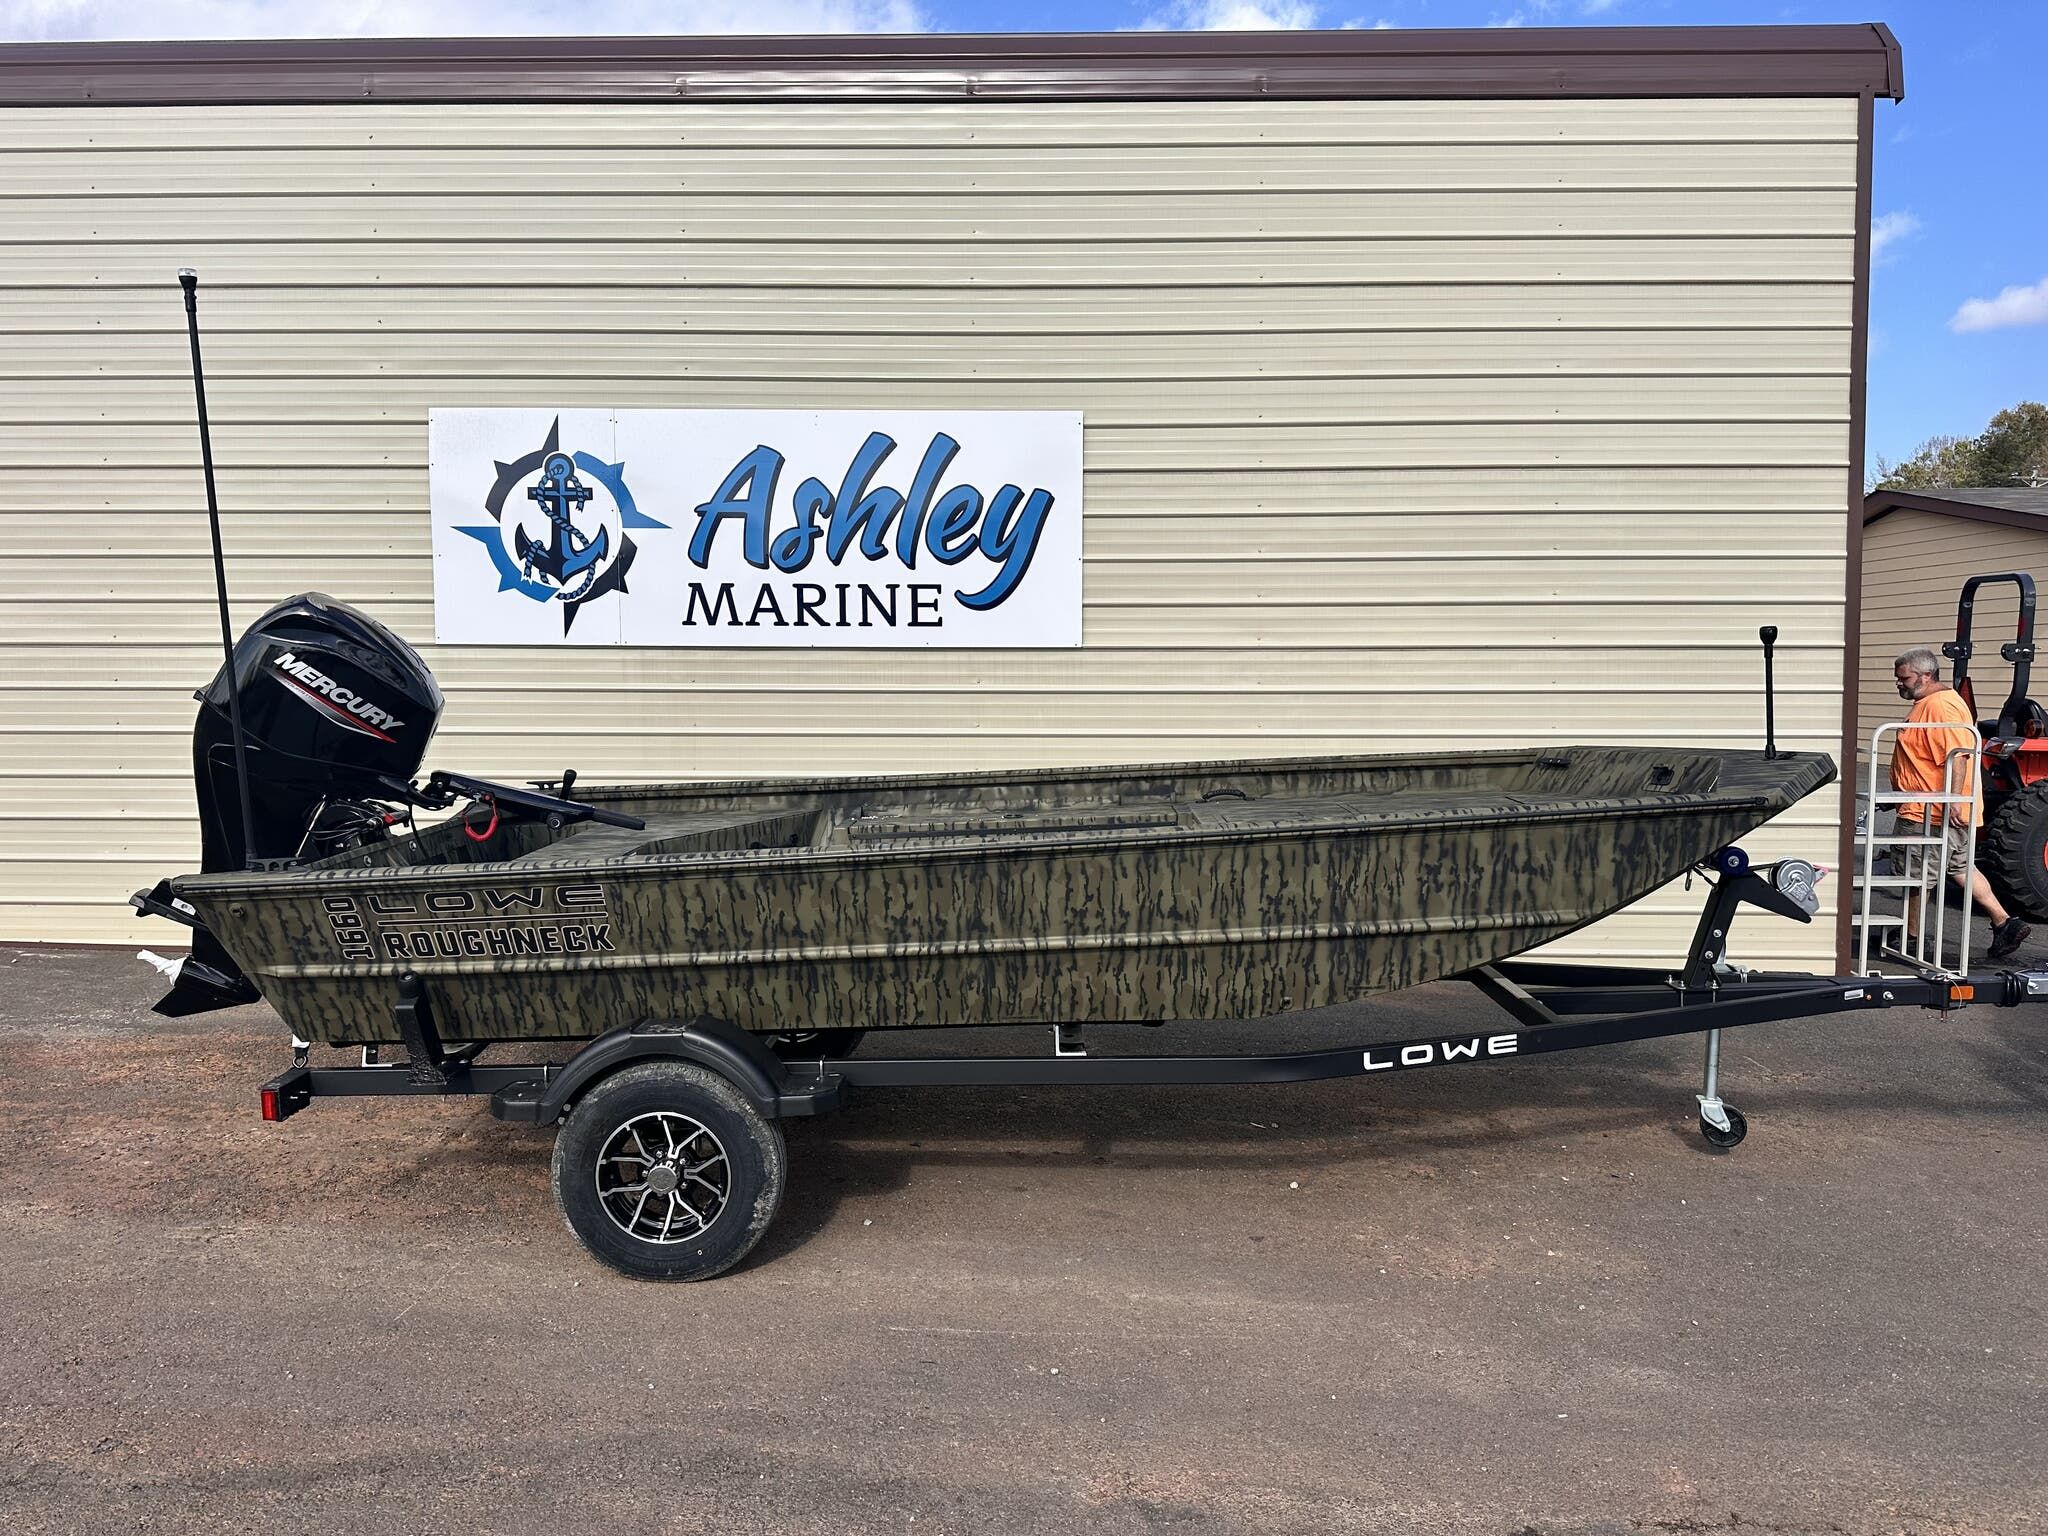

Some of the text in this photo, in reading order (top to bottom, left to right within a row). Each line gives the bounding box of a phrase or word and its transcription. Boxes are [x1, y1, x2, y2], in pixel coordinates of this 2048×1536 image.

[687, 431, 1055, 611] Ashley
[682, 582, 943, 627] MARINE
[273, 652, 405, 731] MERCURY
[367, 885, 606, 914] LOWE
[321, 897, 375, 960] 1660
[381, 924, 615, 959] ROUGHNECK
[1363, 1033, 1518, 1071] LOWE
